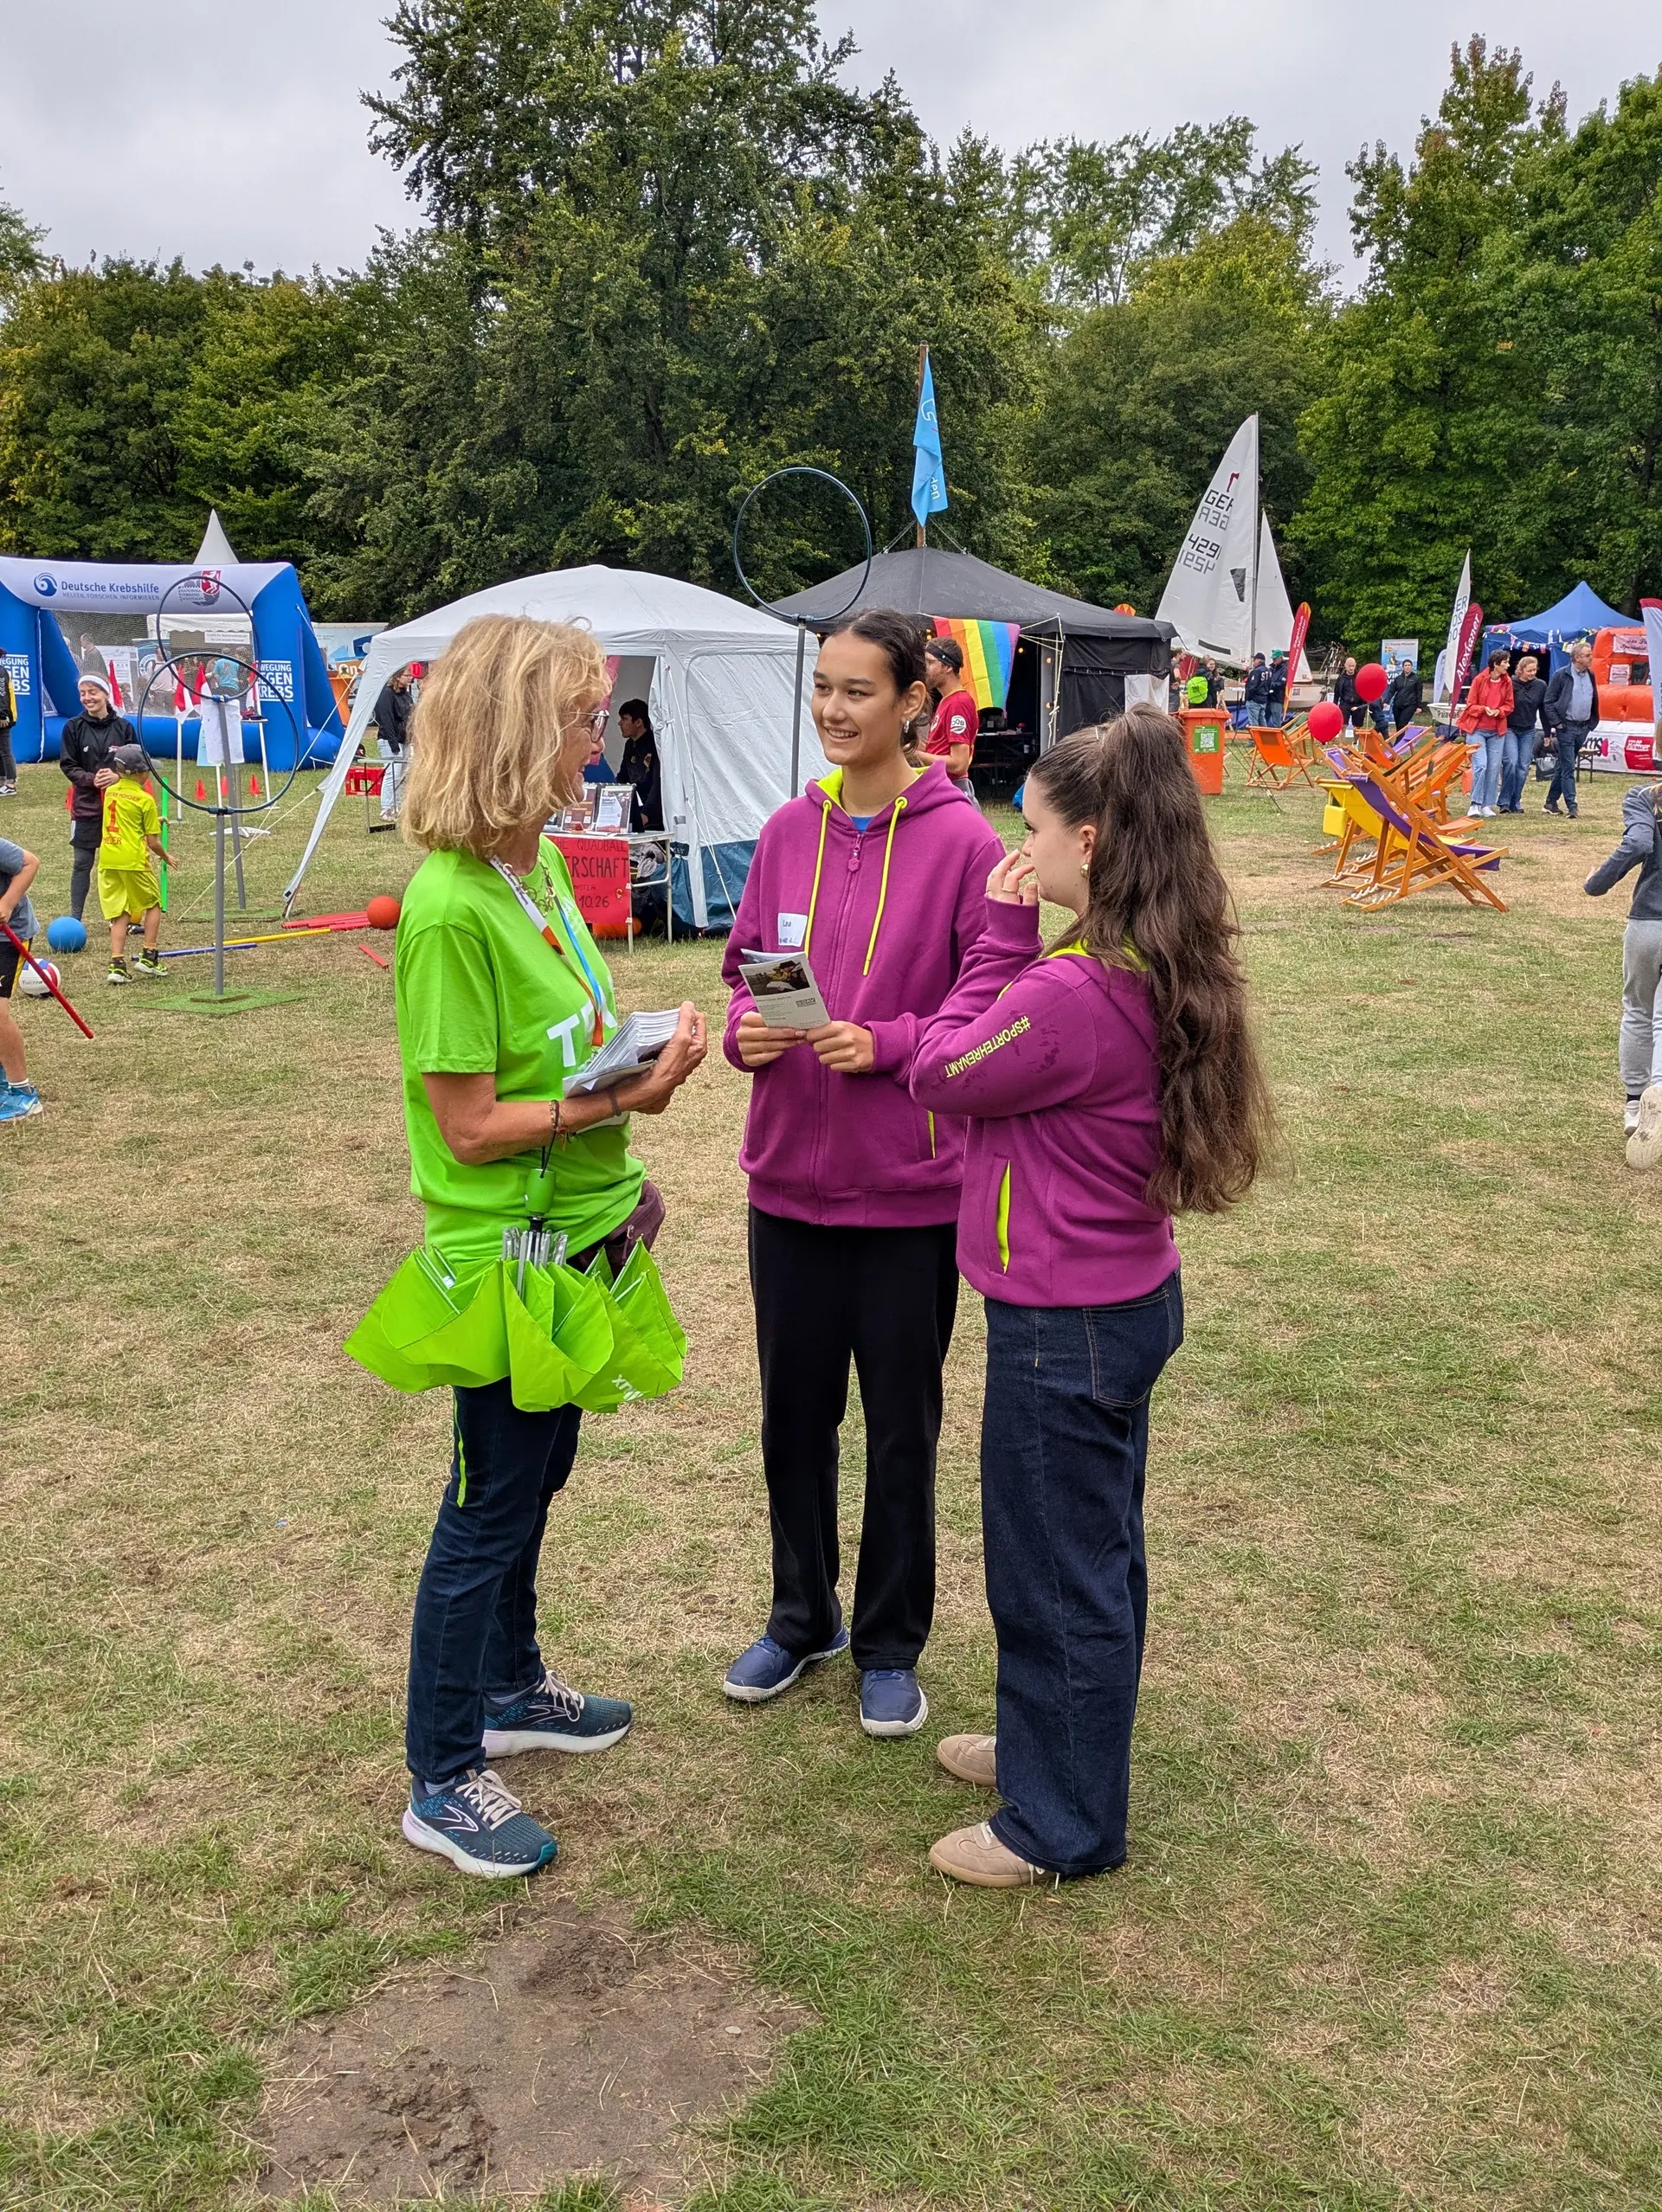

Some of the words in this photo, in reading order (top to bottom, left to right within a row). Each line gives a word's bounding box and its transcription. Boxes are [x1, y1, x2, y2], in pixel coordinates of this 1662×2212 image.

[61, 581, 106, 593] Deutsche
[109, 582, 159, 594] Krebshilfe
[1454, 595, 1468, 613] ER
[0, 657, 29, 666] EGUNG
[106, 799, 119, 833] 1
[577, 839, 629, 852] QUADBALL
[944, 1014, 1032, 1078] #SPORTEHRENAMT
